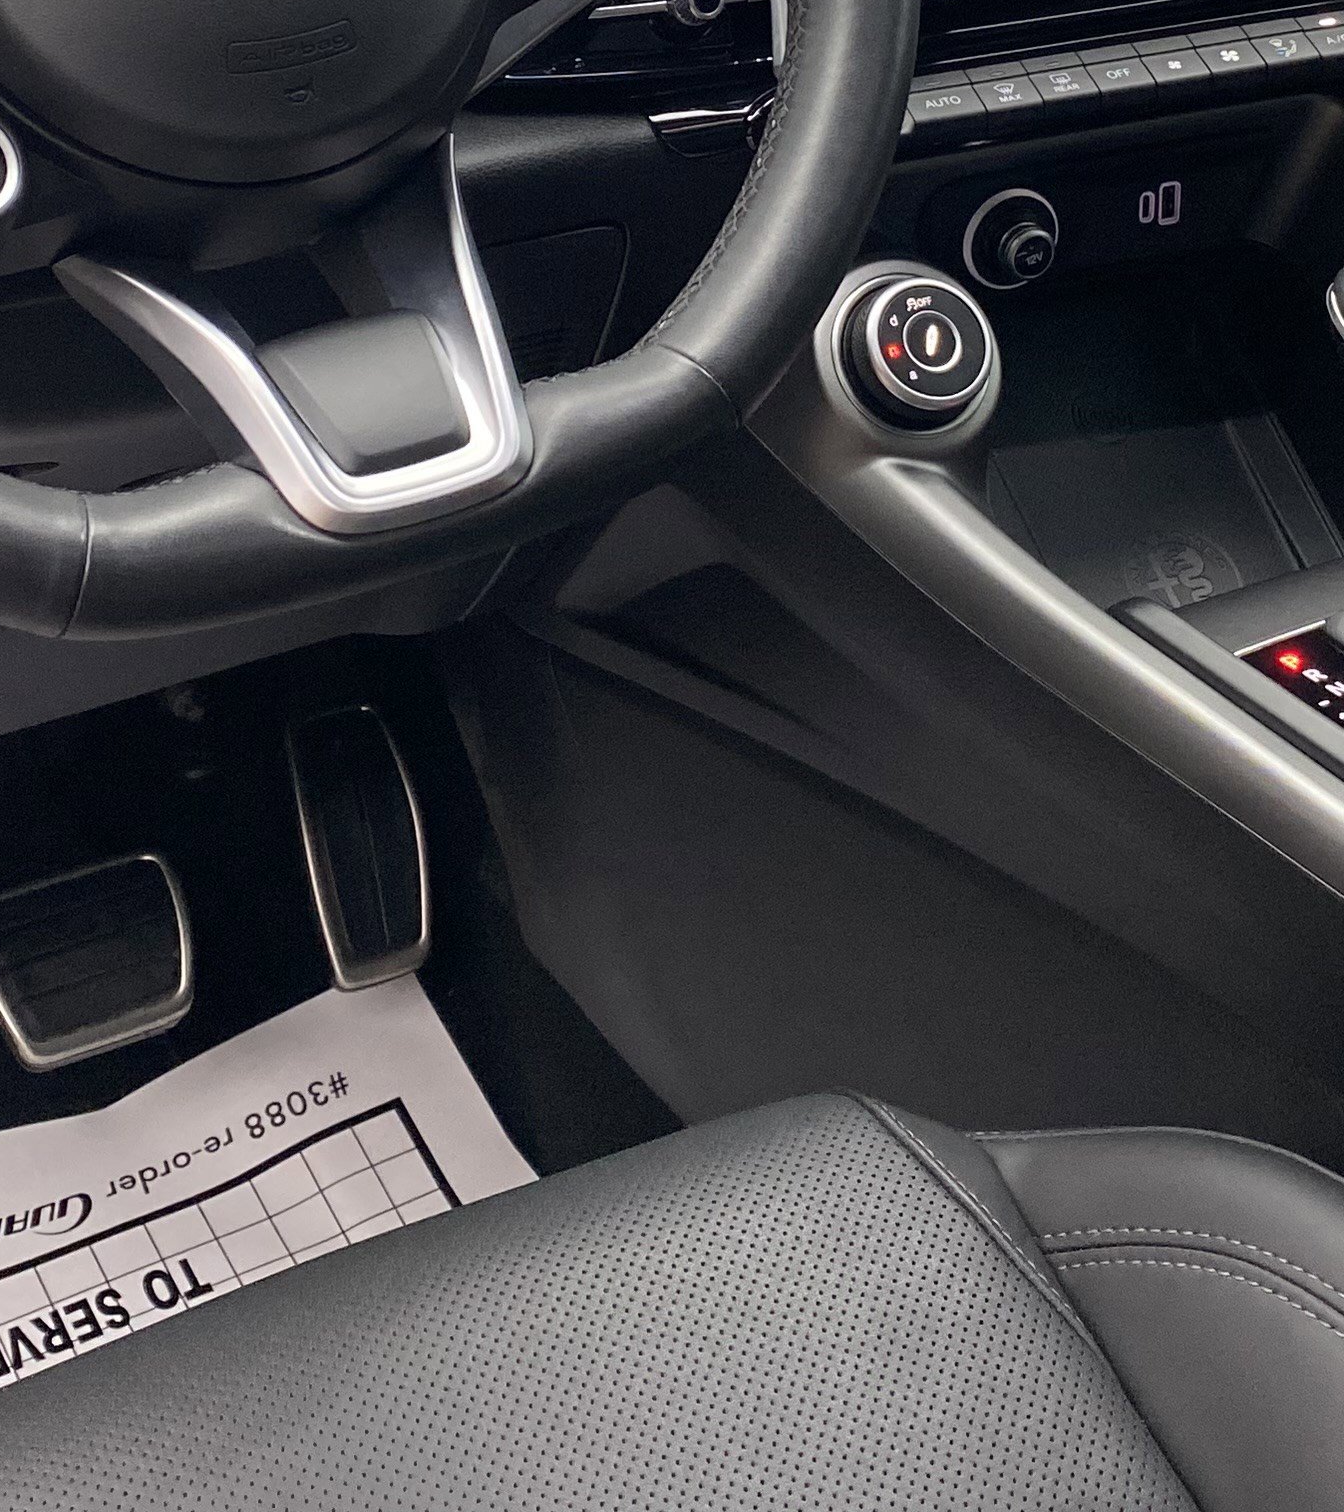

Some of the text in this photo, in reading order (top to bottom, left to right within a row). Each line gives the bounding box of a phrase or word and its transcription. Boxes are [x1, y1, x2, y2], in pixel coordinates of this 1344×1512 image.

[1106, 67, 1131, 80] OFF
[1053, 83, 1080, 94] REAR
[925, 95, 961, 109] AUTO
[999, 92, 1023, 103] MAX
[1025, 251, 1044, 266] 12V
[917, 296, 932, 308] OFF
[1279, 654, 1300, 669] P
[1302, 669, 1328, 683] R
[244, 1071, 349, 1139] #3088
[106, 1127, 233, 1197] re-order
[142, 1258, 214, 1310] TO
